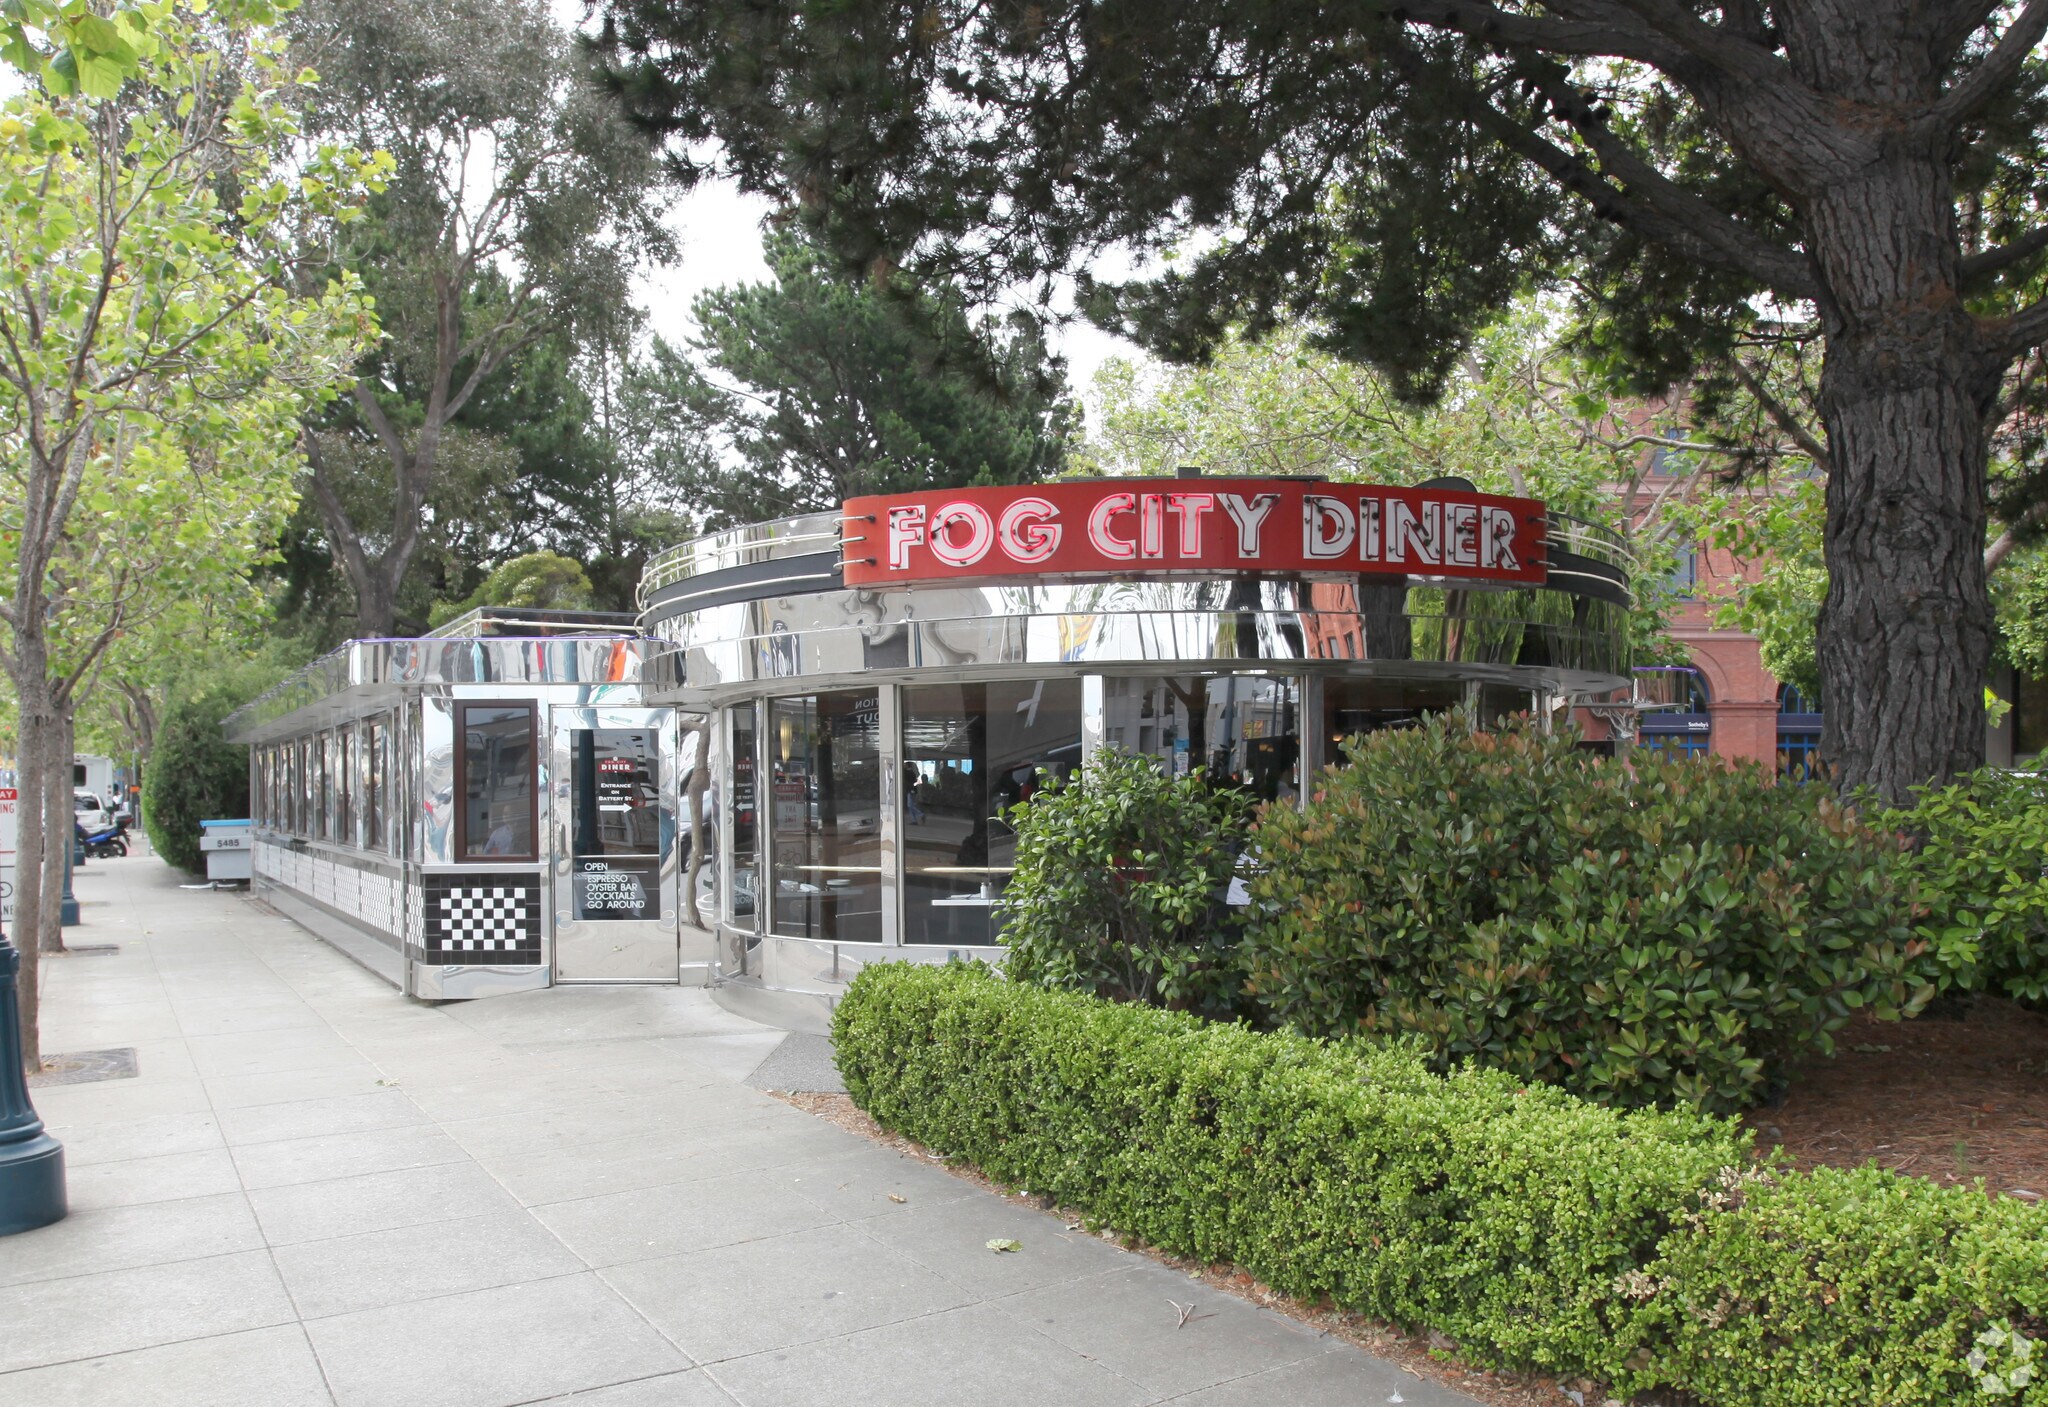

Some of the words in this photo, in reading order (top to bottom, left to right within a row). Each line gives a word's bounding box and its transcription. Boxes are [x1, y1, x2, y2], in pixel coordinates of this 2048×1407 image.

[888, 497, 1063, 570] FOG
[1087, 493, 1281, 560] CITY
[1303, 494, 1521, 571] DINER
[584, 862, 608, 871] OPEN
[620, 883, 638, 891] BAR
[607, 900, 645, 909] AROUND
